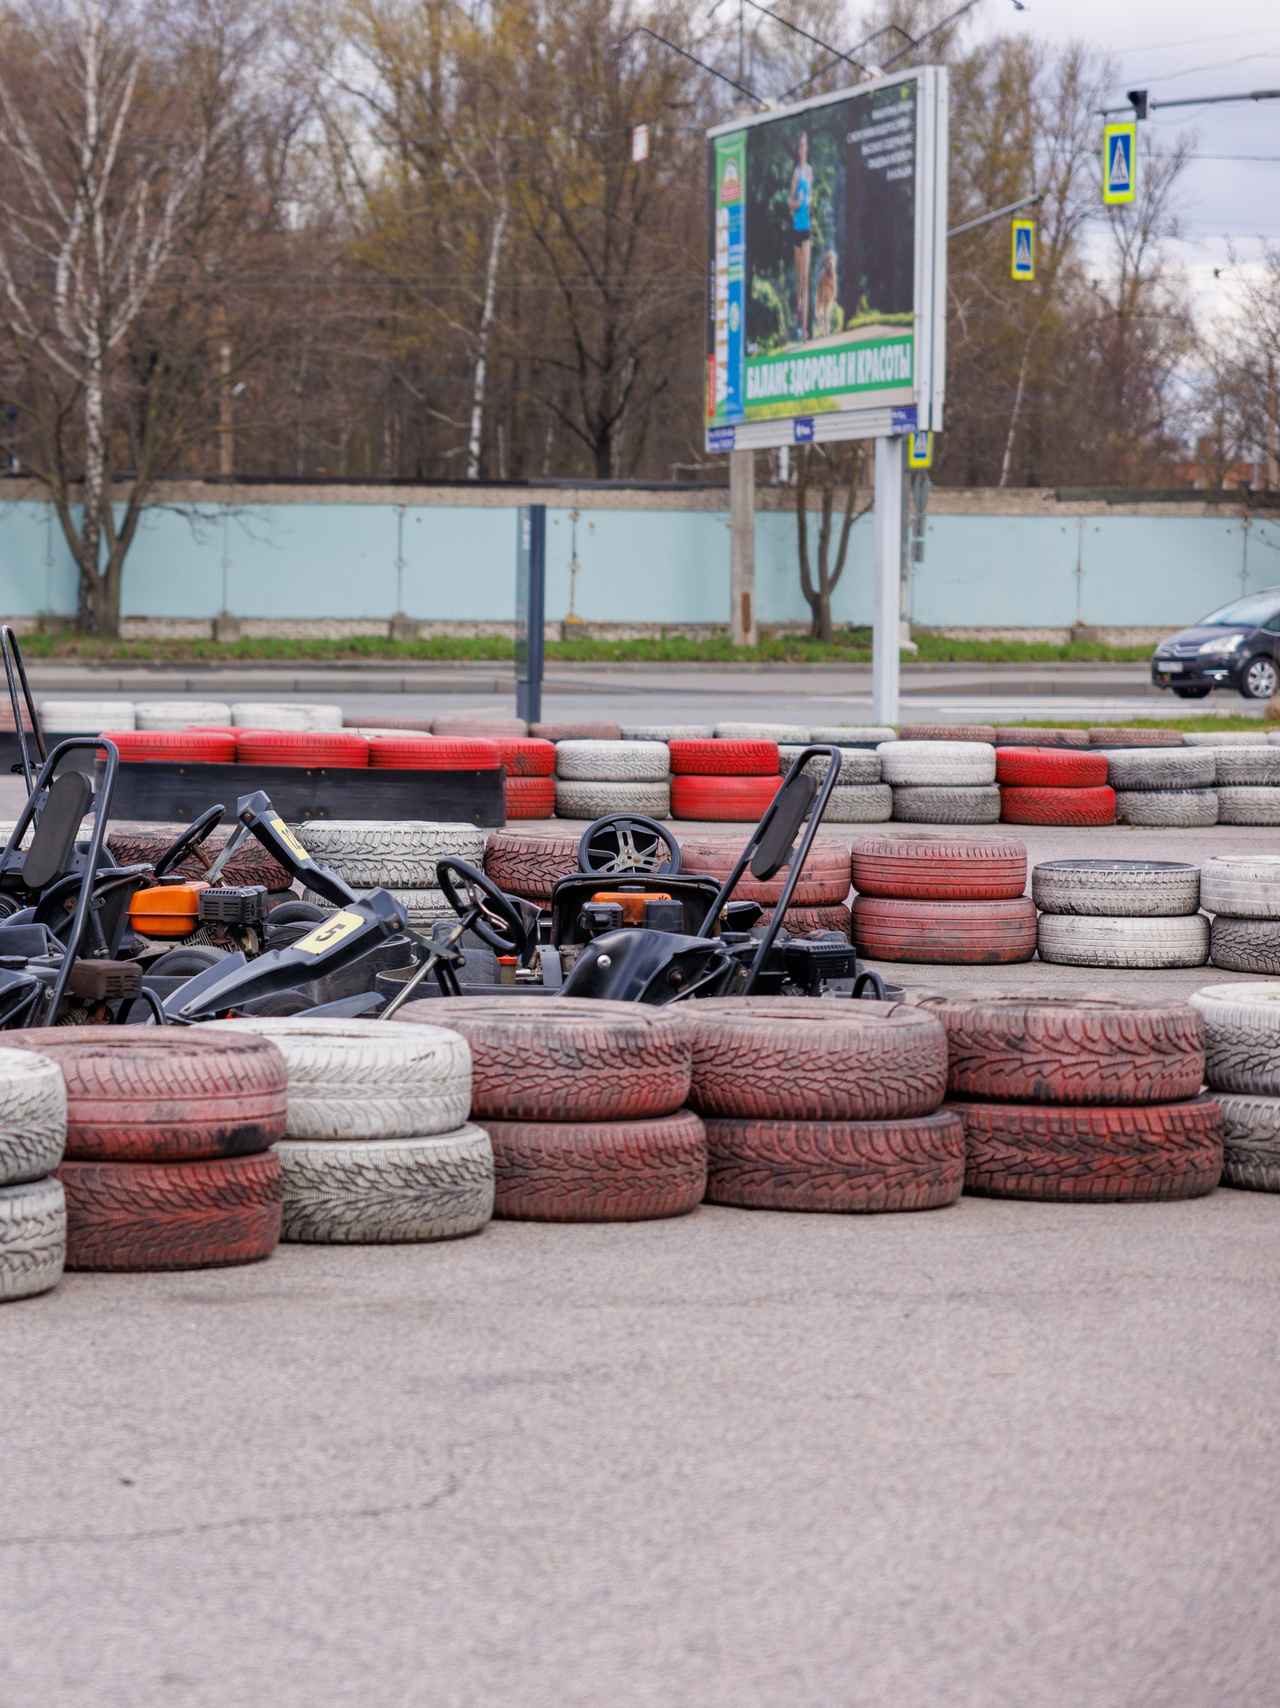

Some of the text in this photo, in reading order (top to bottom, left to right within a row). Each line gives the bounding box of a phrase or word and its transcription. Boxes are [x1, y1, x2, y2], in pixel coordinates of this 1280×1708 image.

[715, 207, 730, 403] WELLNESS
[746, 343, 911, 399] БАЛАНС ЗДОРОВЬЯ И КРАСОТЫ
[281, 828, 302, 850] 12
[315, 923, 347, 942] 5
